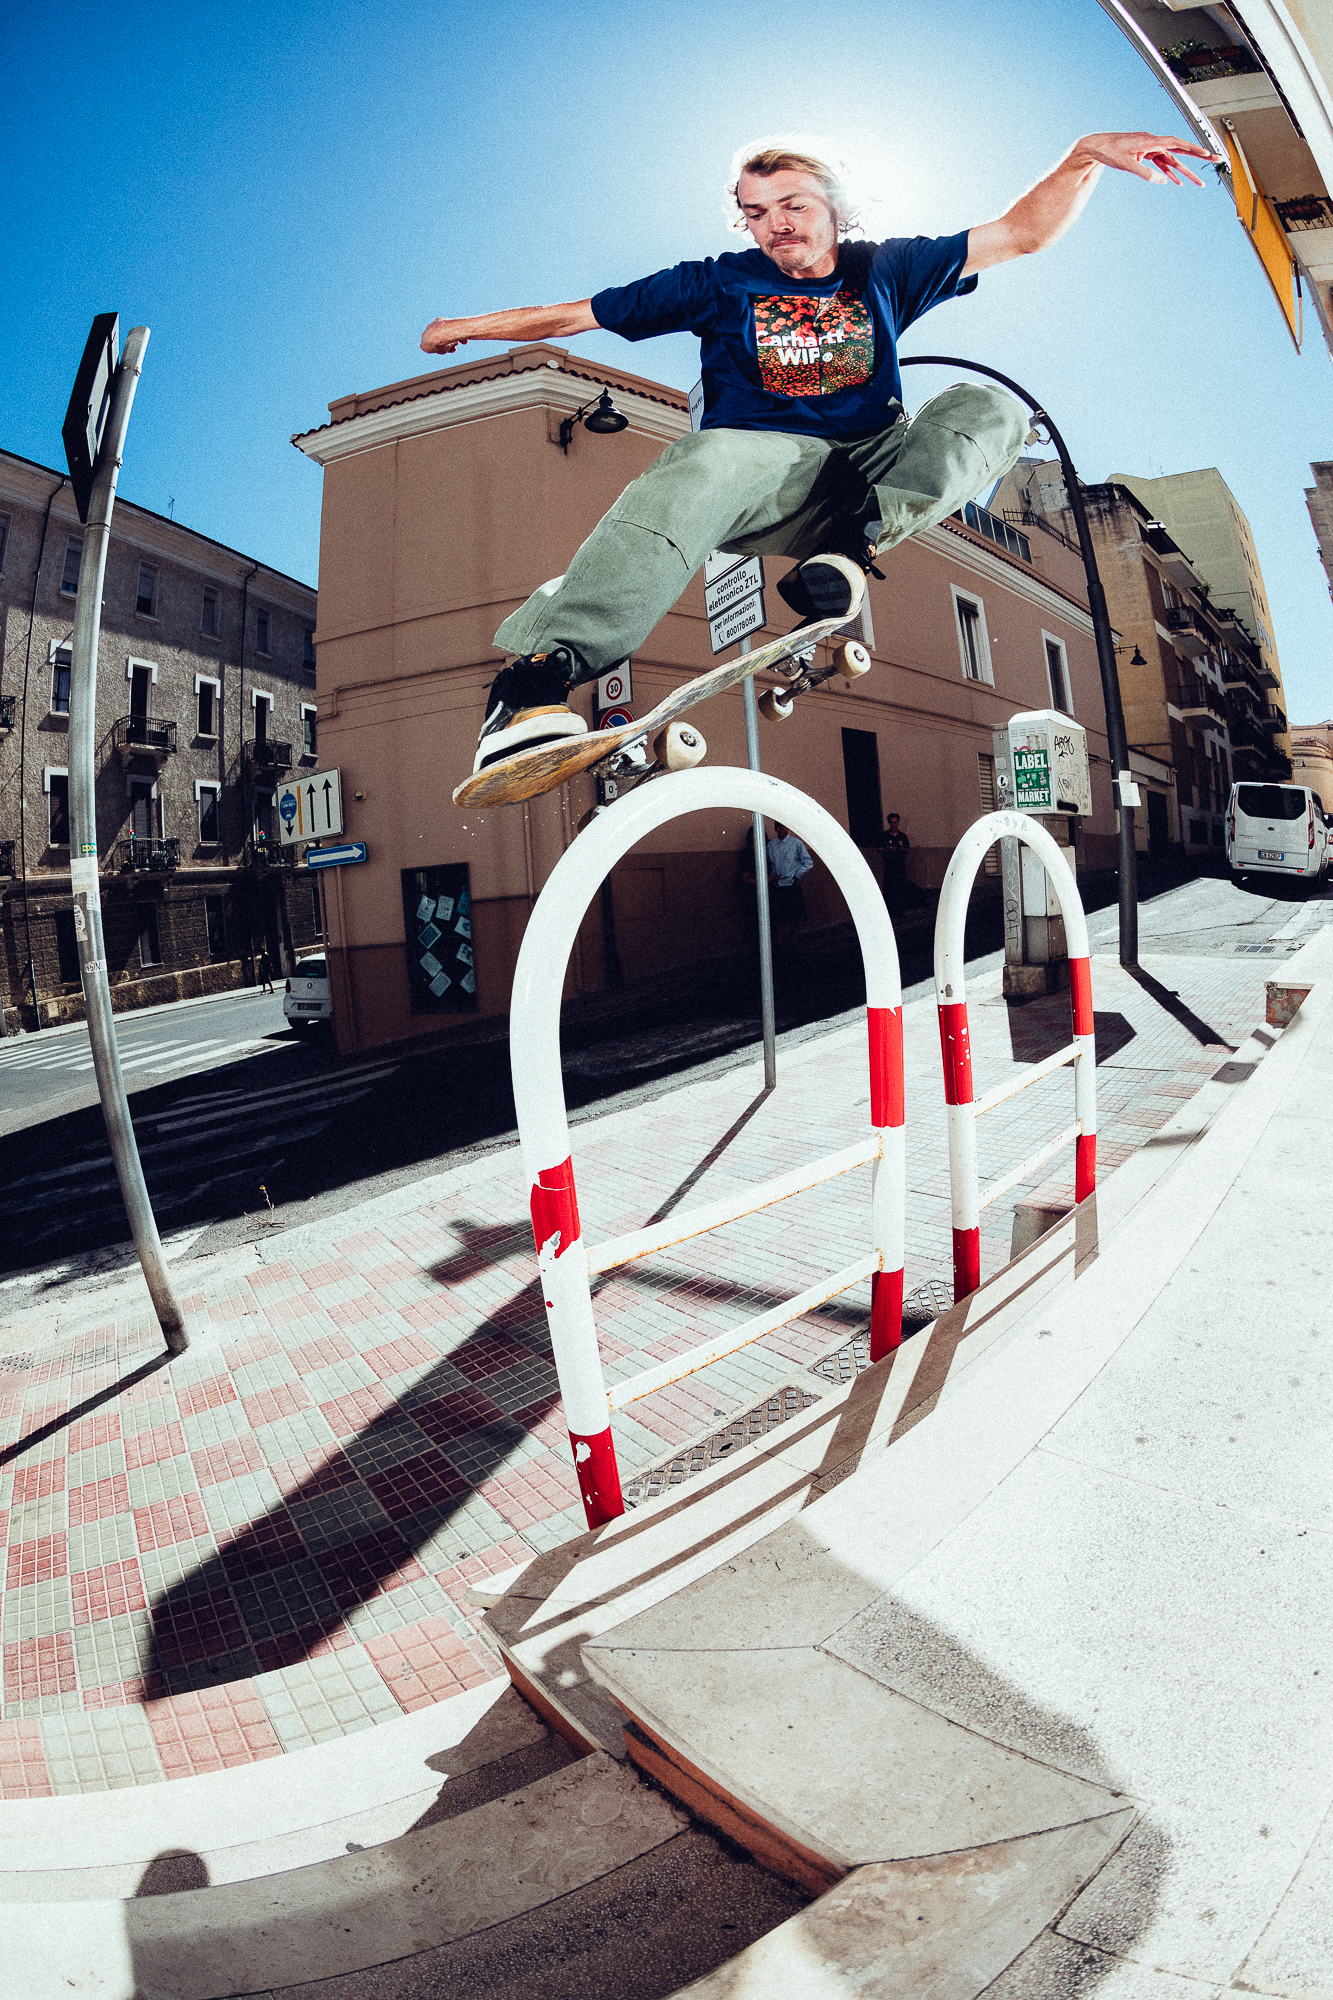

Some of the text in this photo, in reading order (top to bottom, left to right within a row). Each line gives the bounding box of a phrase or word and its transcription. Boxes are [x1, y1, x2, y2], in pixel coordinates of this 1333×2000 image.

[756, 329, 846, 348] Carhartt
[716, 570, 747, 595] controllo
[708, 574, 759, 612] elettronico ZTL
[714, 620, 723, 633] per
[609, 683, 619, 694] 30
[1015, 753, 1048, 770] LABEL
[1017, 790, 1050, 803] MARKET
